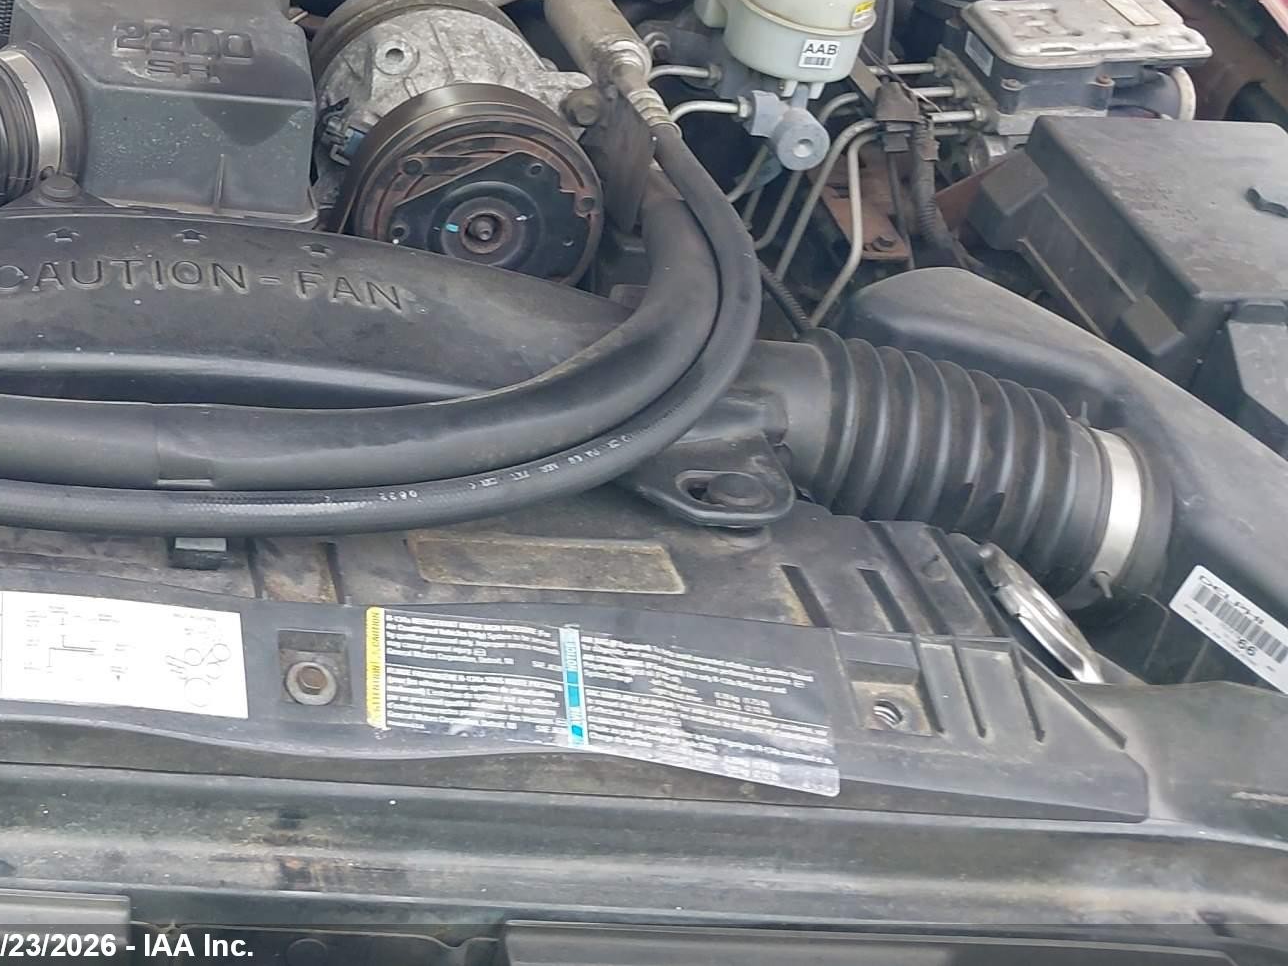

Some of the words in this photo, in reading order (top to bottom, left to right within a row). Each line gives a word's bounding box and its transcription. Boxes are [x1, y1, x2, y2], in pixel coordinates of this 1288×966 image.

[112, 23, 253, 60] 2200
[804, 42, 838, 56] AAB
[295, 268, 411, 315] FAN
